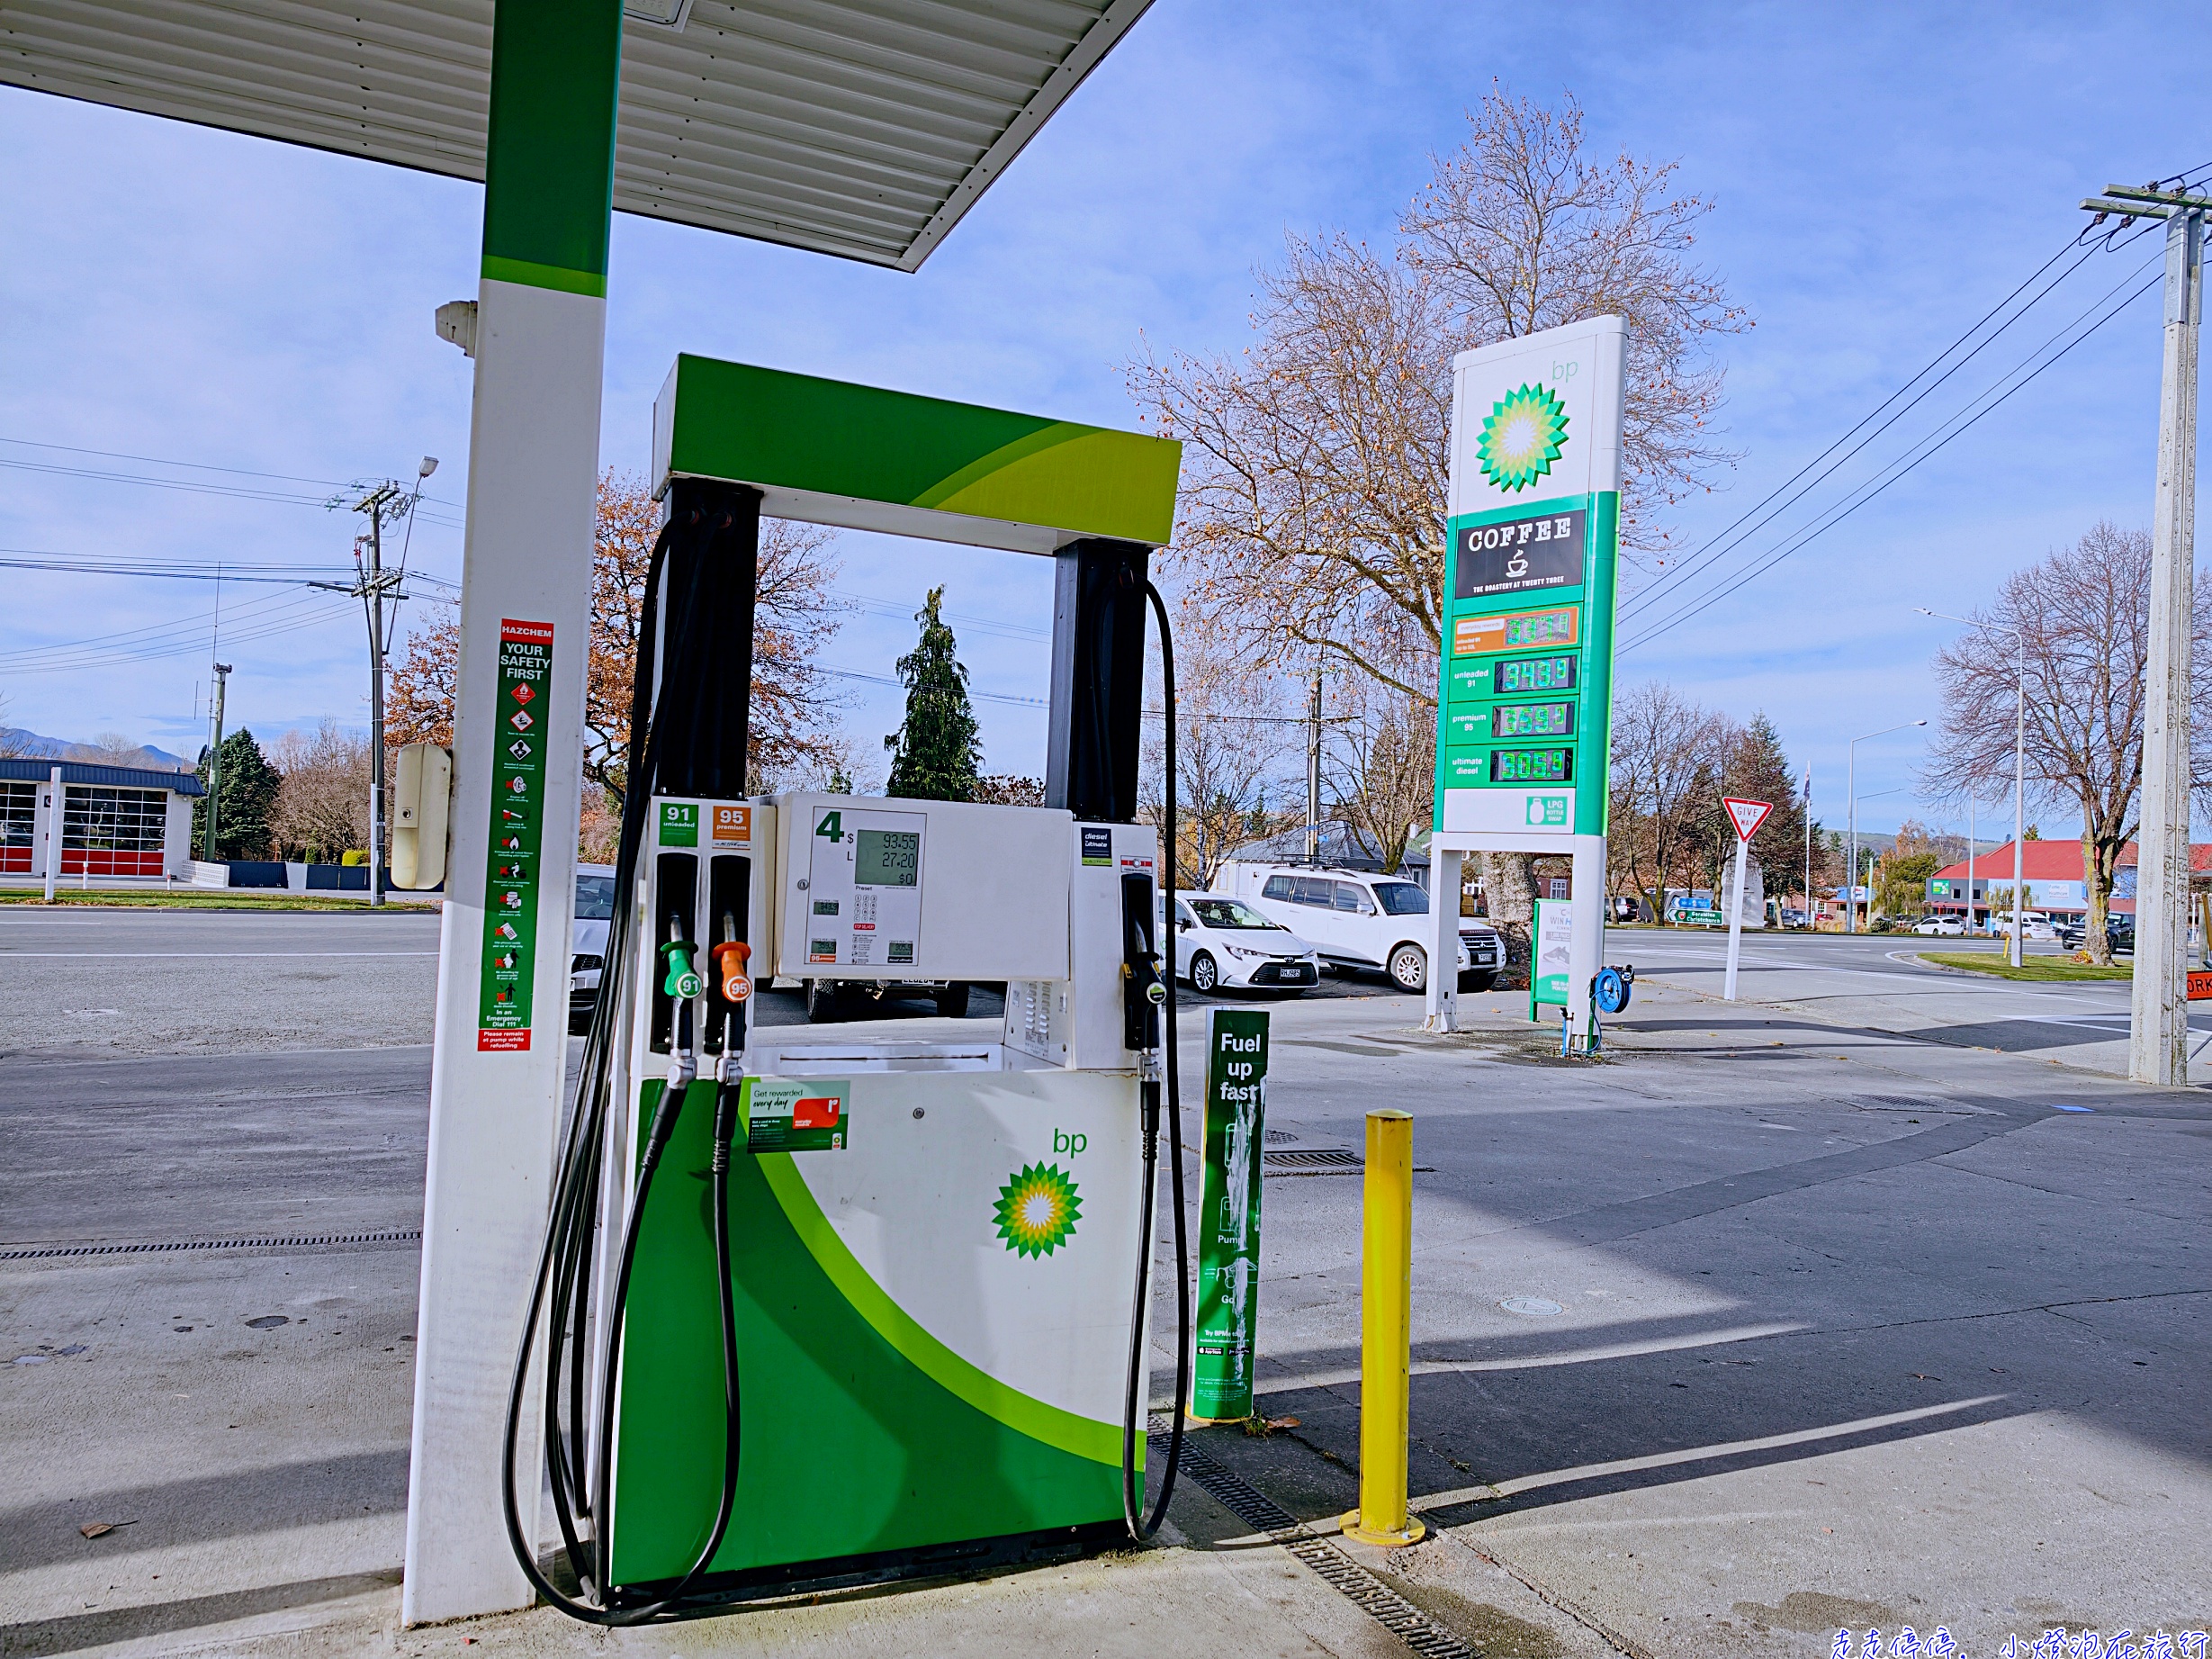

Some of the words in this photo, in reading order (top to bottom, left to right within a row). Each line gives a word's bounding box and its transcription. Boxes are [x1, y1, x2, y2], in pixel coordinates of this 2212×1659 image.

[1551, 360, 1578, 383] bp
[1468, 517, 1571, 552] COFFEE
[1473, 585, 1484, 593] THE
[502, 626, 552, 638] HAZCHEM
[506, 643, 543, 656] YOUR
[500, 655, 551, 669] SAFETY
[507, 667, 544, 681] FIRST
[1454, 670, 1488, 680] unleaded
[1452, 714, 1487, 724] premium
[1547, 800, 1563, 808] LPG
[667, 807, 689, 821] 91
[720, 810, 743, 824] 95
[1737, 807, 1758, 817] GIVE
[815, 811, 845, 843] 4
[1741, 819, 1754, 827] WAY
[847, 833, 854, 844] $
[883, 834, 916, 849] 93.55
[847, 851, 853, 861] L
[882, 852, 915, 868] 27.20
[682, 980, 698, 992] 91
[731, 983, 748, 995] 95
[1221, 1033, 1261, 1052] Fuel
[1227, 1062, 1253, 1080] up
[769, 1088, 804, 1096] rewarded
[1220, 1082, 1260, 1100] fast
[753, 1100, 773, 1110] every
[774, 1097, 788, 1109] day
[1053, 1128, 1088, 1159] bp
